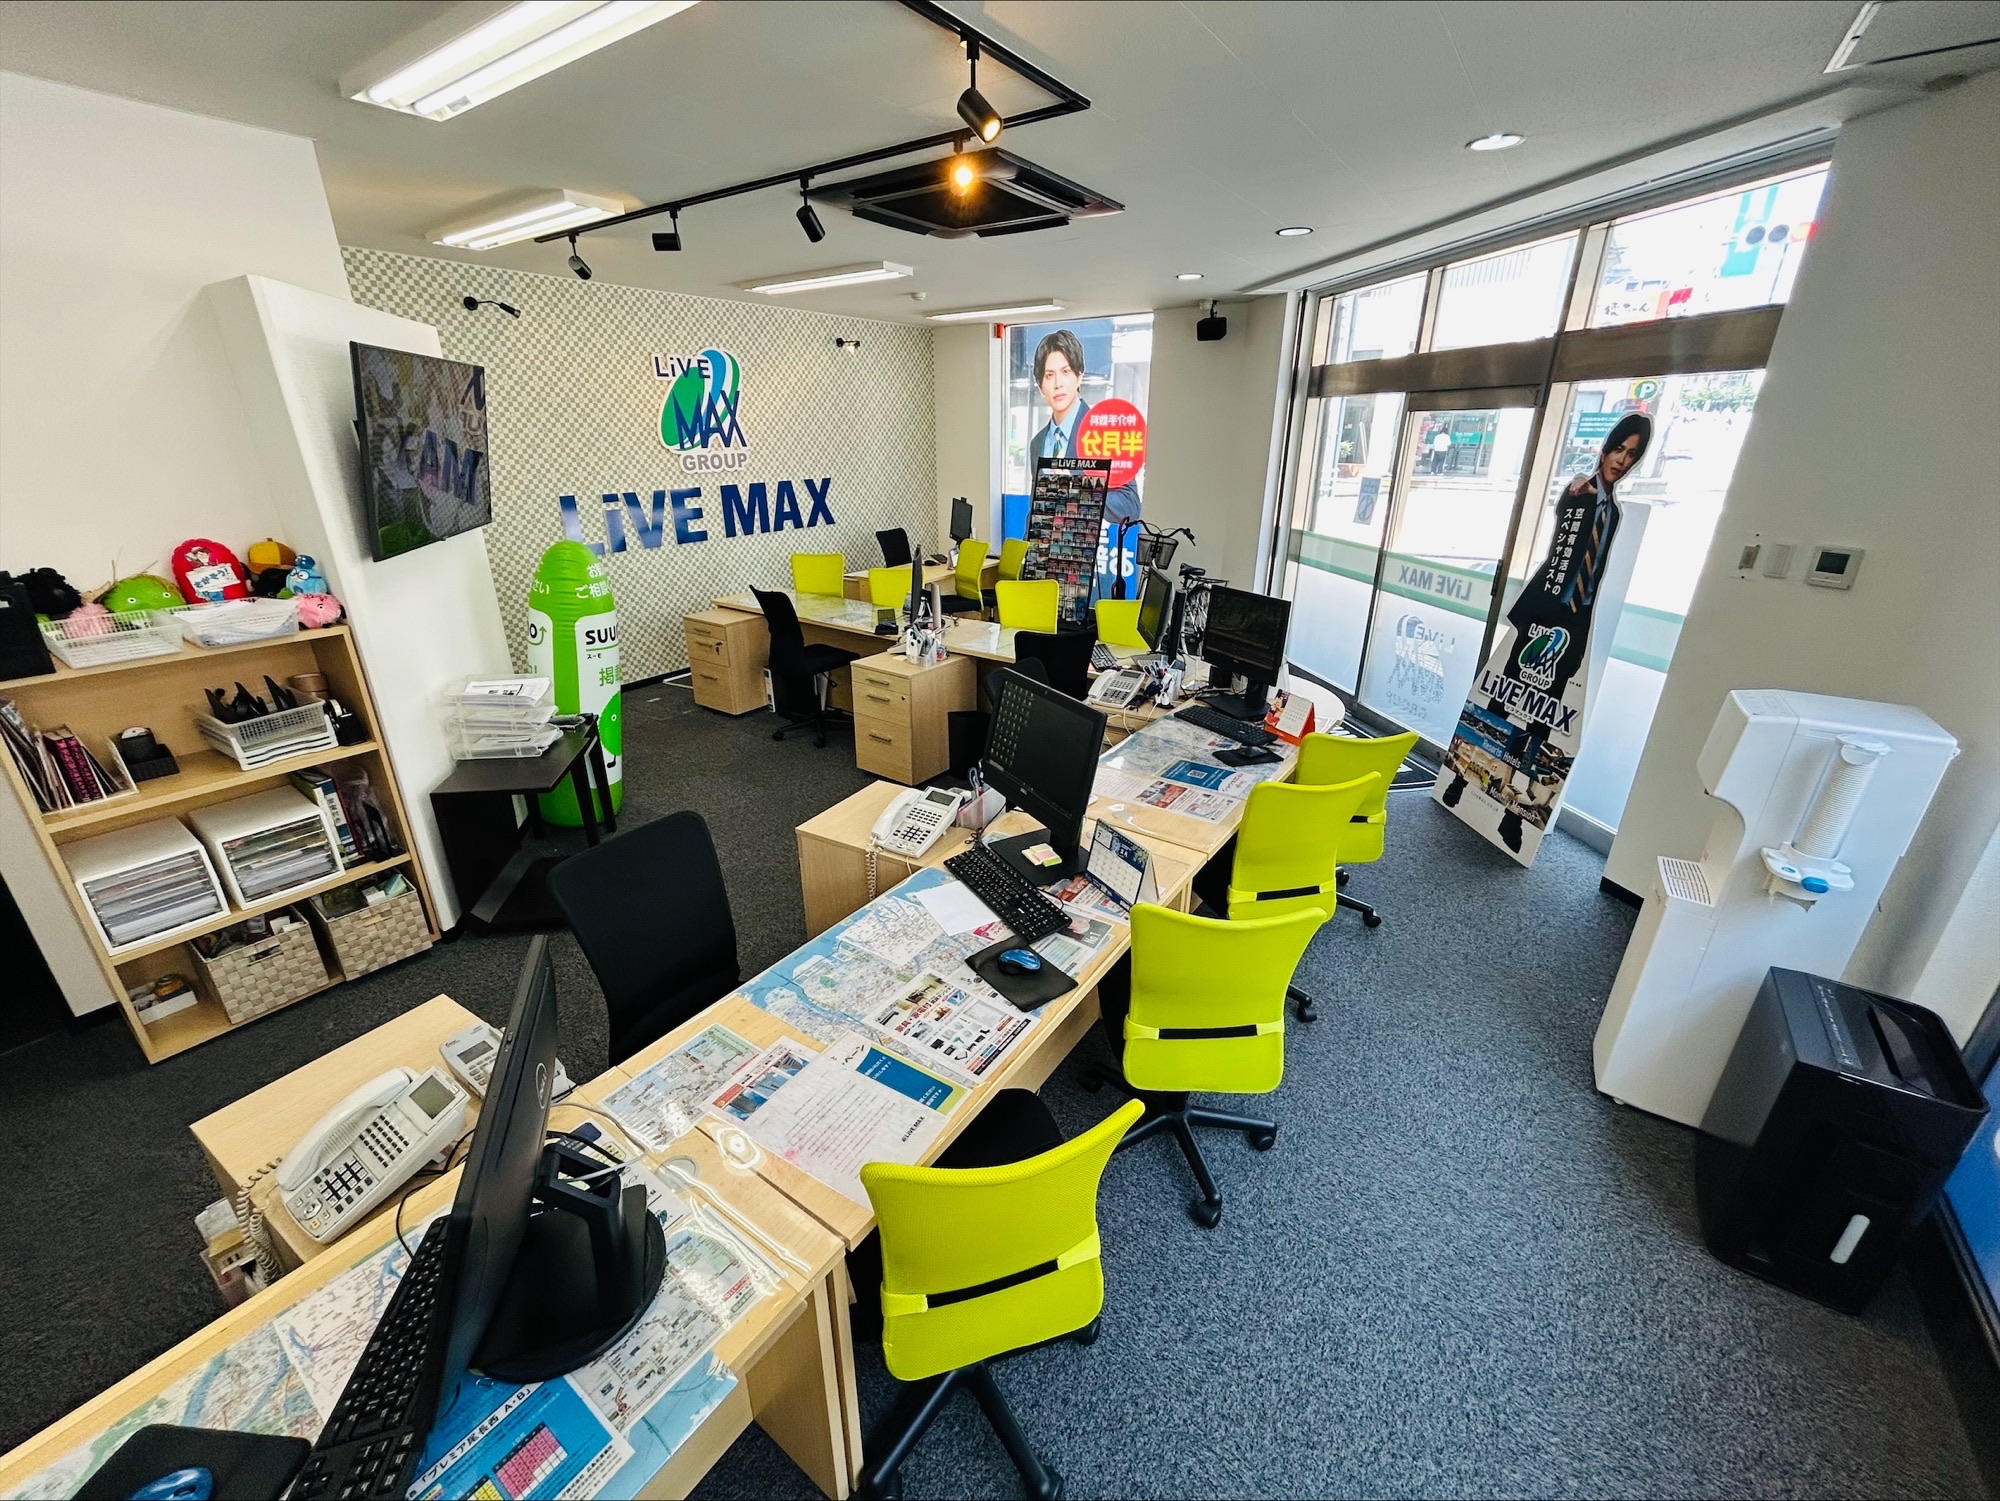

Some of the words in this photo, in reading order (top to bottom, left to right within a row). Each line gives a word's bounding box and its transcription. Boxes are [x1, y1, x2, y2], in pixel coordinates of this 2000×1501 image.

[655, 356, 711, 379] LiVE
[672, 389, 748, 450] MAX
[682, 453, 748, 471] GROUP
[1077, 460, 1097, 468] MAX
[720, 477, 836, 538] MAX
[1543, 508, 1573, 591] スペシャリスト
[1552, 507, 1585, 596] 空間有効活用の
[1521, 670, 1551, 688] GROUP
[1480, 669, 1525, 708] LiVE
[1521, 688, 1578, 733] MAX
[1482, 738, 1503, 757] Resorts
[1502, 751, 1522, 770] Hotels
[1511, 800, 1536, 823] Mansion
